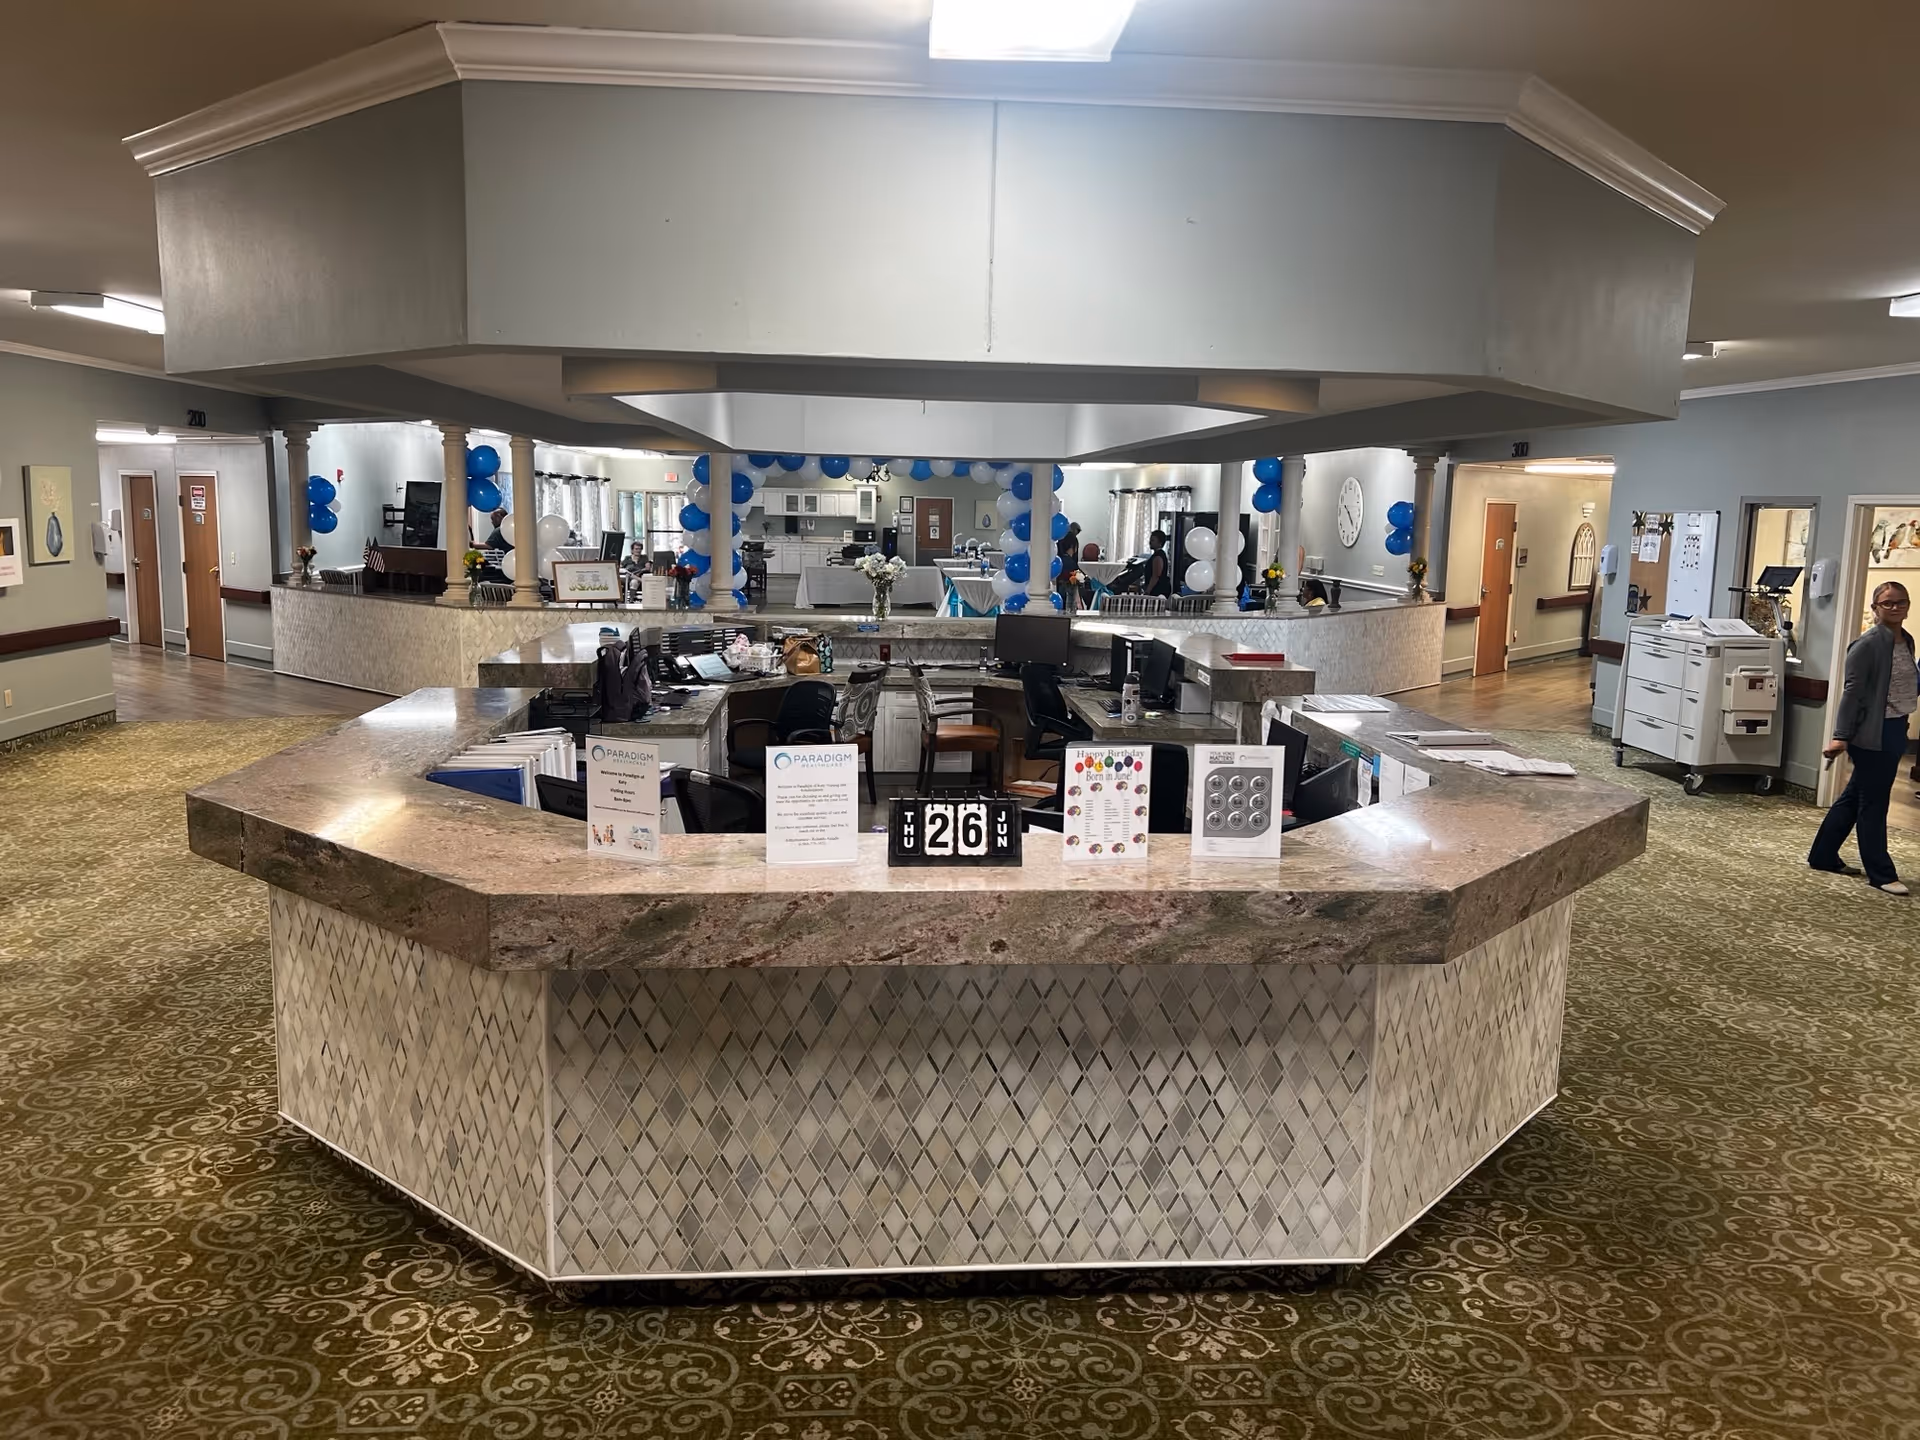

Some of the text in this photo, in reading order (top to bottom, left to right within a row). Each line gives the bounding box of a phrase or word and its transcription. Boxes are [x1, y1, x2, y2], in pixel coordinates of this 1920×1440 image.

[187, 409, 206, 427] 200
[1511, 441, 1529, 458] 300
[606, 749, 654, 761] PARADIGM
[793, 753, 852, 763] PARADIGM
[1076, 749, 1145, 759] Happy Birthday
[1085, 770, 1133, 781] Born in June!
[903, 811, 915, 849] THU
[996, 810, 1008, 848] JUN
